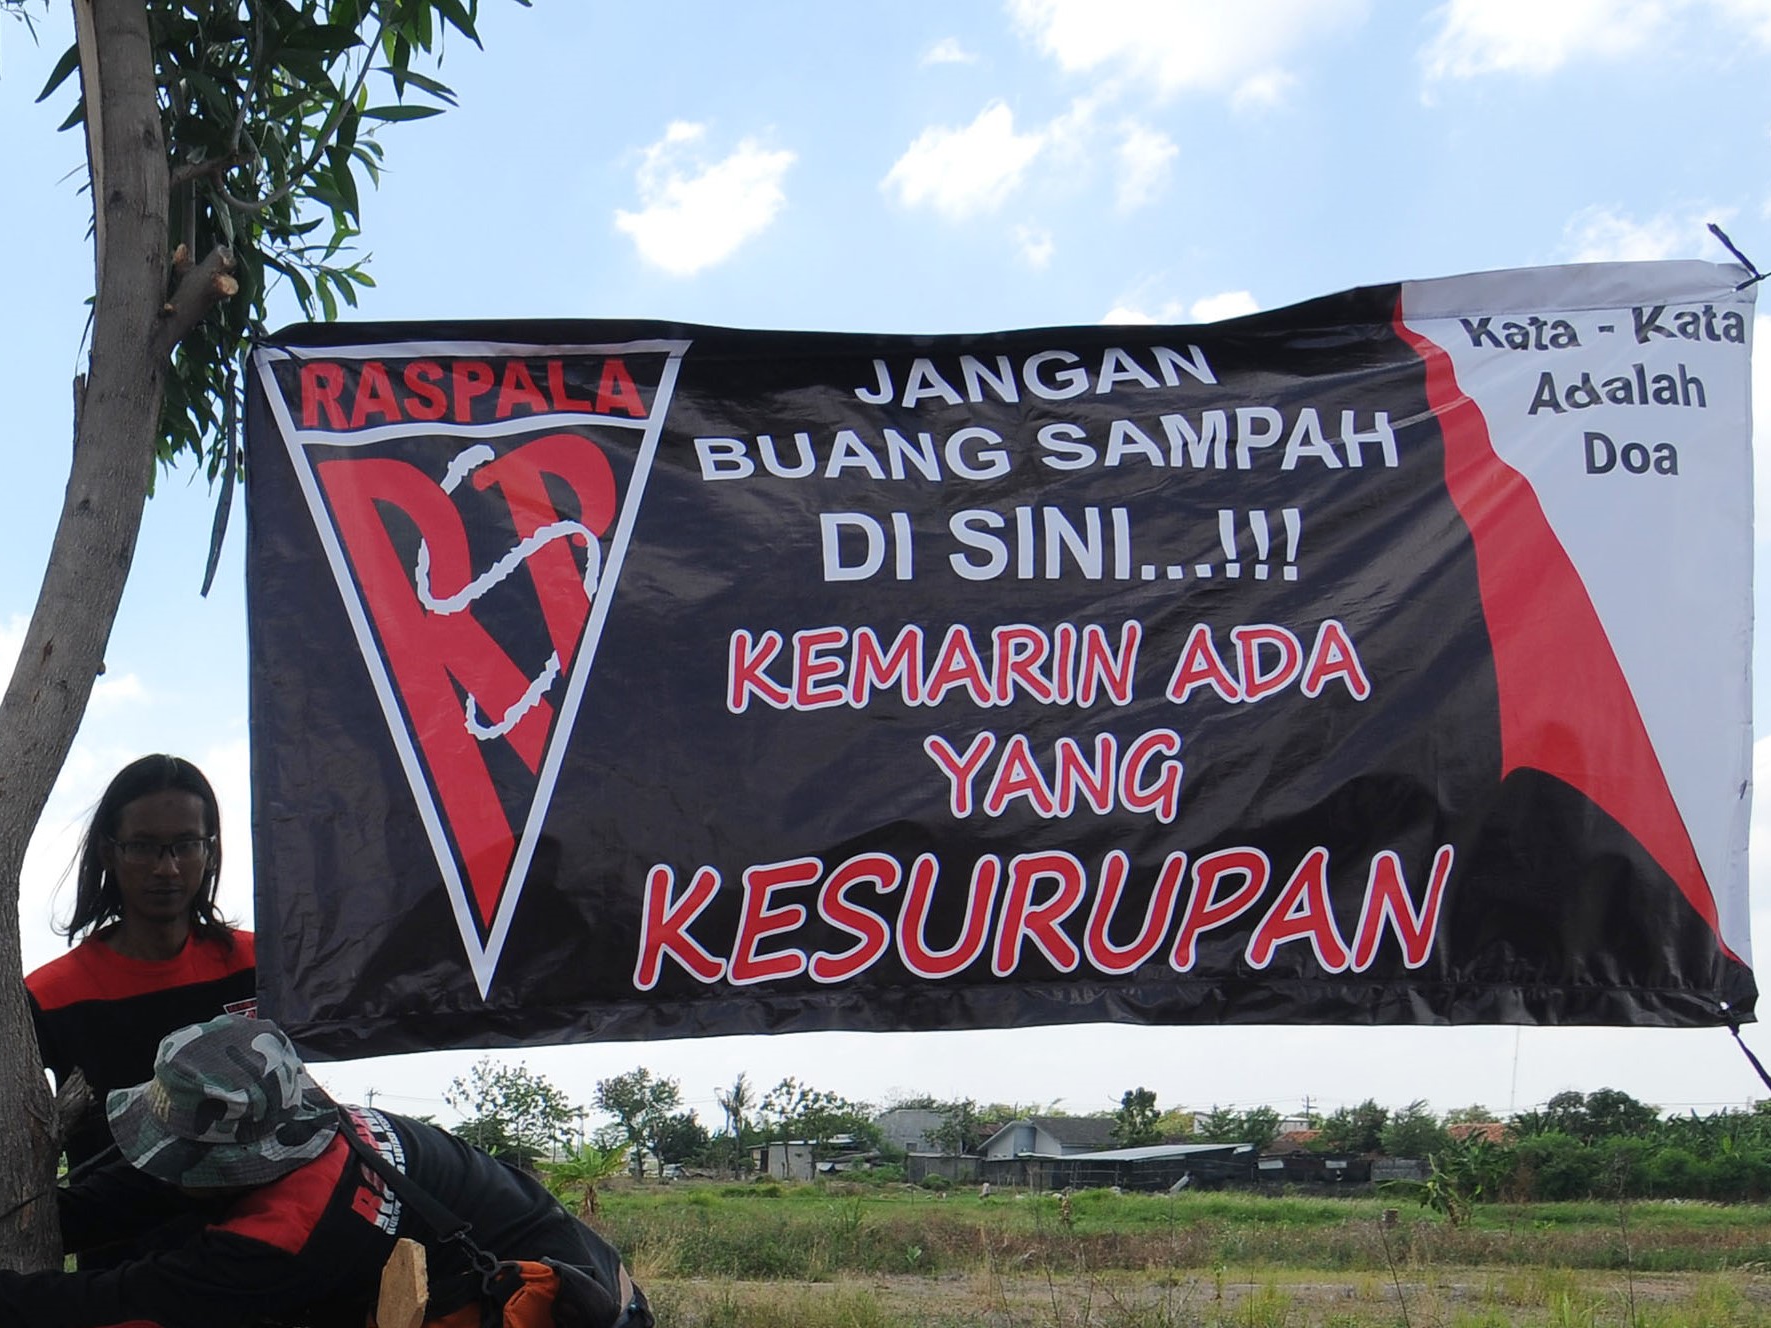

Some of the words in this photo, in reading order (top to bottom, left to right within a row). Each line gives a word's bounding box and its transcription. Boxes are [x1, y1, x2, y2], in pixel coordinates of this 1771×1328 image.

[1459, 314, 1582, 351] Kata
[1632, 304, 1747, 346] Kata
[300, 357, 647, 429] RASPALA
[855, 344, 1219, 408] JANGAN
[1527, 362, 1708, 416] Adalah
[693, 427, 1012, 482] BUANG
[1043, 406, 1401, 472] SAMPAH
[1584, 431, 1680, 476] Doa
[818, 510, 915, 582] DI
[948, 505, 1303, 582] SINI...!!!
[727, 620, 1143, 714] KEMARIN
[1166, 618, 1371, 706] ADA
[923, 728, 1184, 824] YANG
[633, 844, 1455, 990] KESURUPAN
